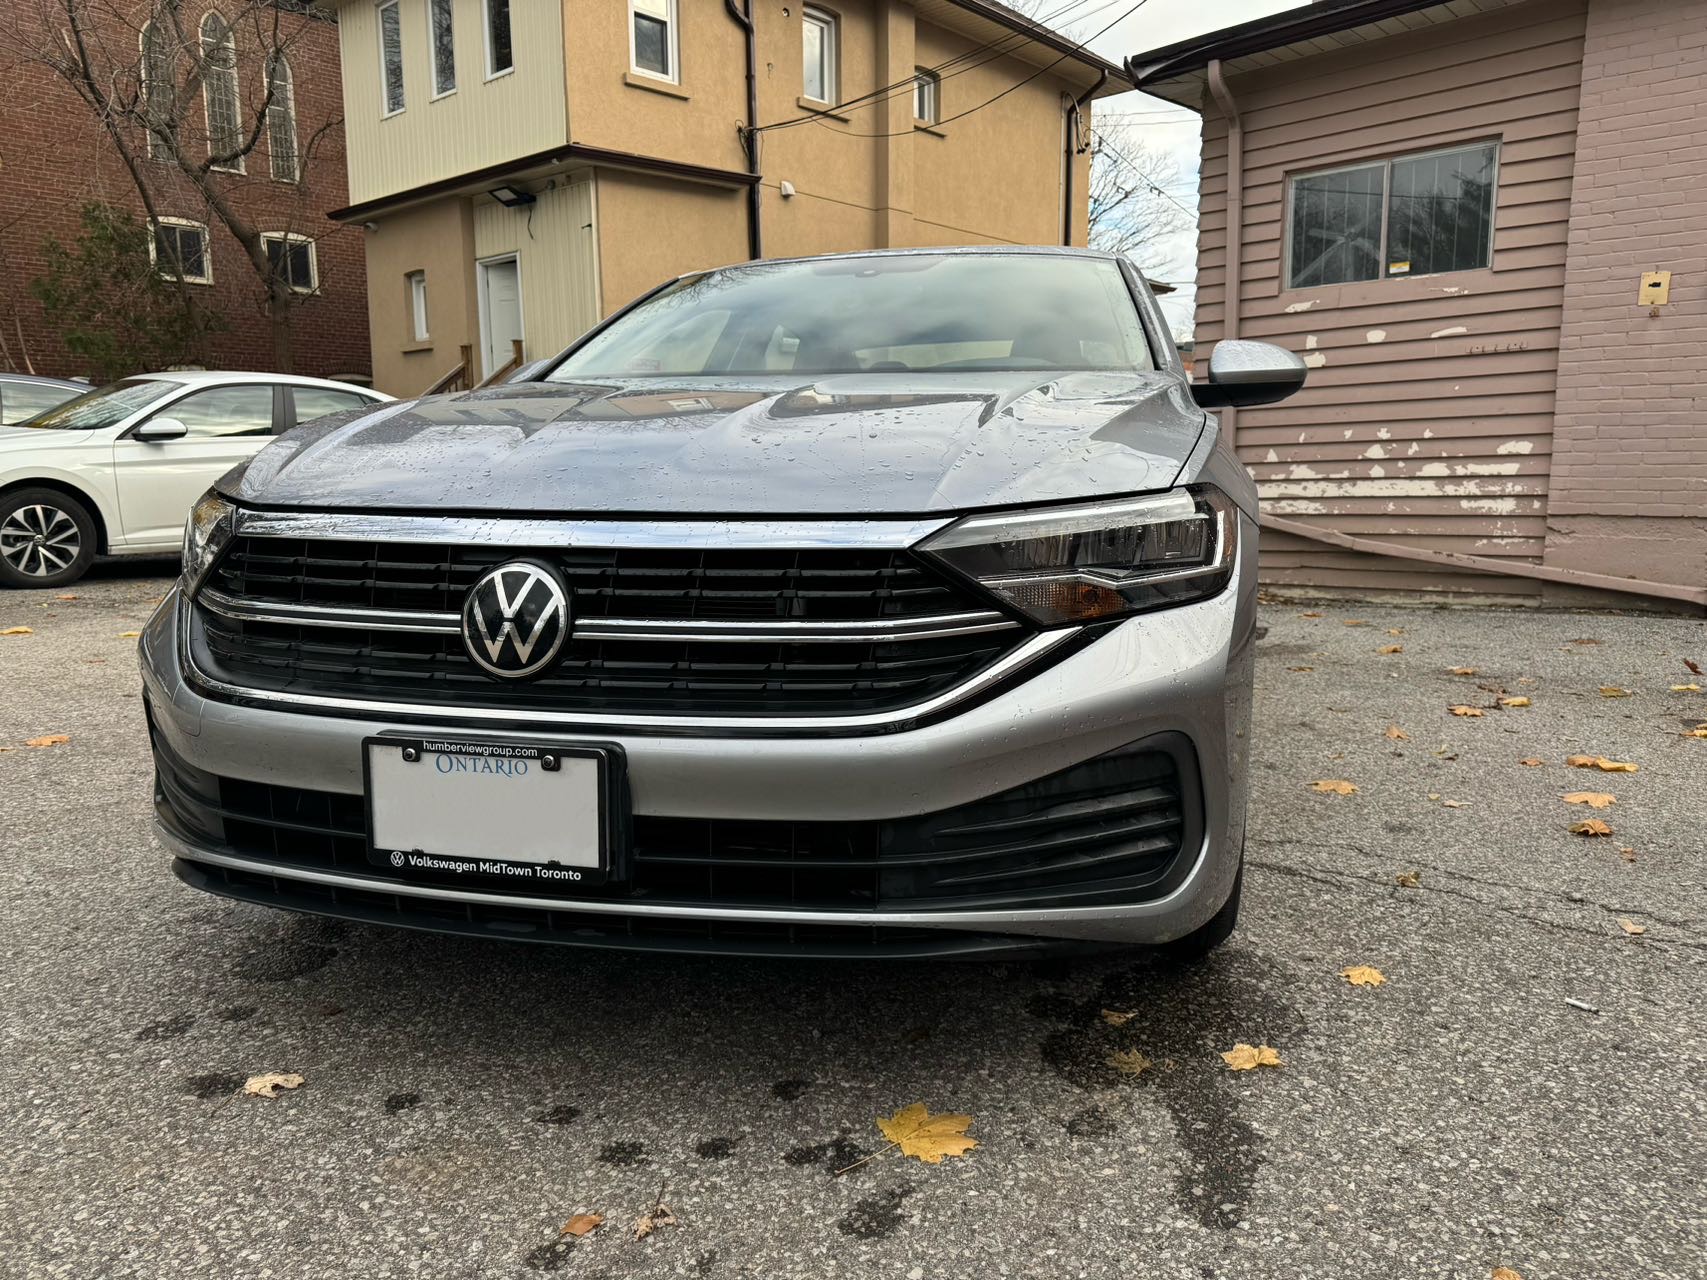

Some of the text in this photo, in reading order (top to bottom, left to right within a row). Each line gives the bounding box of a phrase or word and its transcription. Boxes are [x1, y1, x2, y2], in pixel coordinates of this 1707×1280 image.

[422, 740, 539, 758] humberviewgroup.com
[435, 753, 529, 778] ONTARIO
[408, 854, 582, 881] Volkswagen MidTown Toronto
